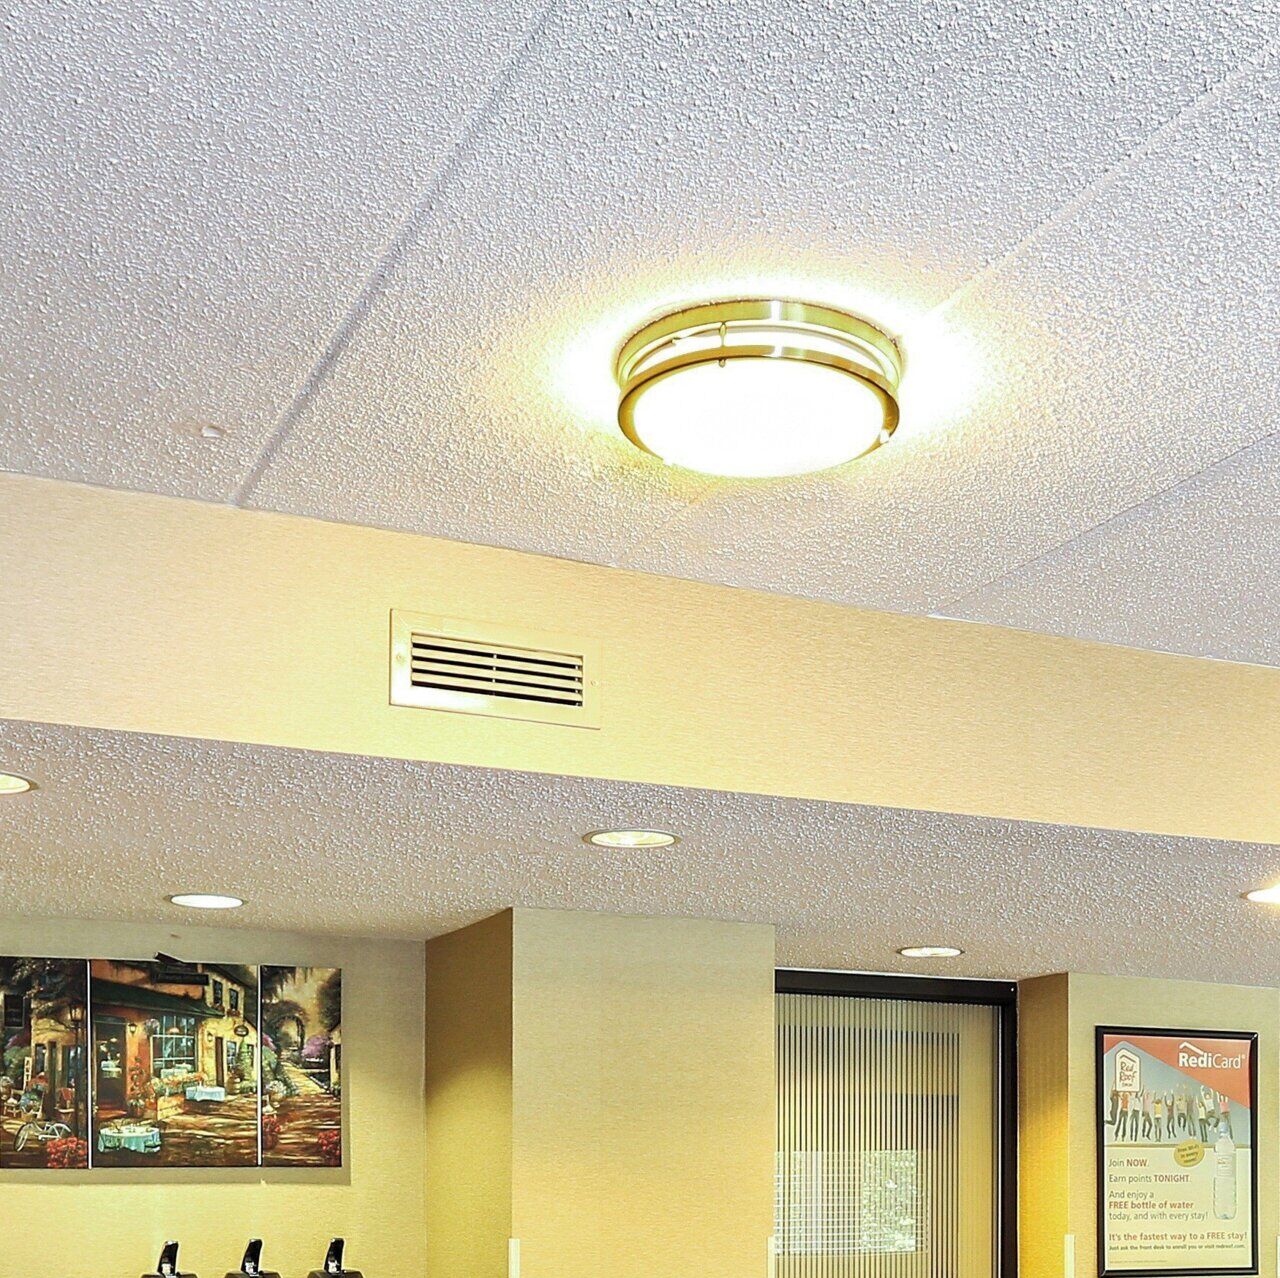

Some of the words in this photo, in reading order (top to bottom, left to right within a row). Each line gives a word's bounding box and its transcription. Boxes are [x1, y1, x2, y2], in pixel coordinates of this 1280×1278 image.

[1109, 1159, 1124, 1168] Join
[1109, 1174, 1126, 1183] Earn
[1128, 1174, 1152, 1184] points
[1109, 1190, 1125, 1199] And
[1126, 1190, 1148, 1200] enjoy
[1108, 1201, 1129, 1210] FREE
[1130, 1200, 1156, 1210] bottle
[1158, 1200, 1168, 1208] of
[1110, 1212, 1132, 1222] today,
[1134, 1212, 1148, 1220] and
[1150, 1212, 1168, 1220] with
[1169, 1213, 1189, 1222] every
[1191, 1212, 1208, 1222] stay!
[1108, 1233, 1120, 1241] It's
[1124, 1232, 1138, 1240] the
[1140, 1232, 1168, 1240] fastest
[1170, 1234, 1187, 1242] way
[1189, 1232, 1198, 1240] to
[1206, 1232, 1225, 1240] FREE
[1227, 1232, 1248, 1241] stay!
